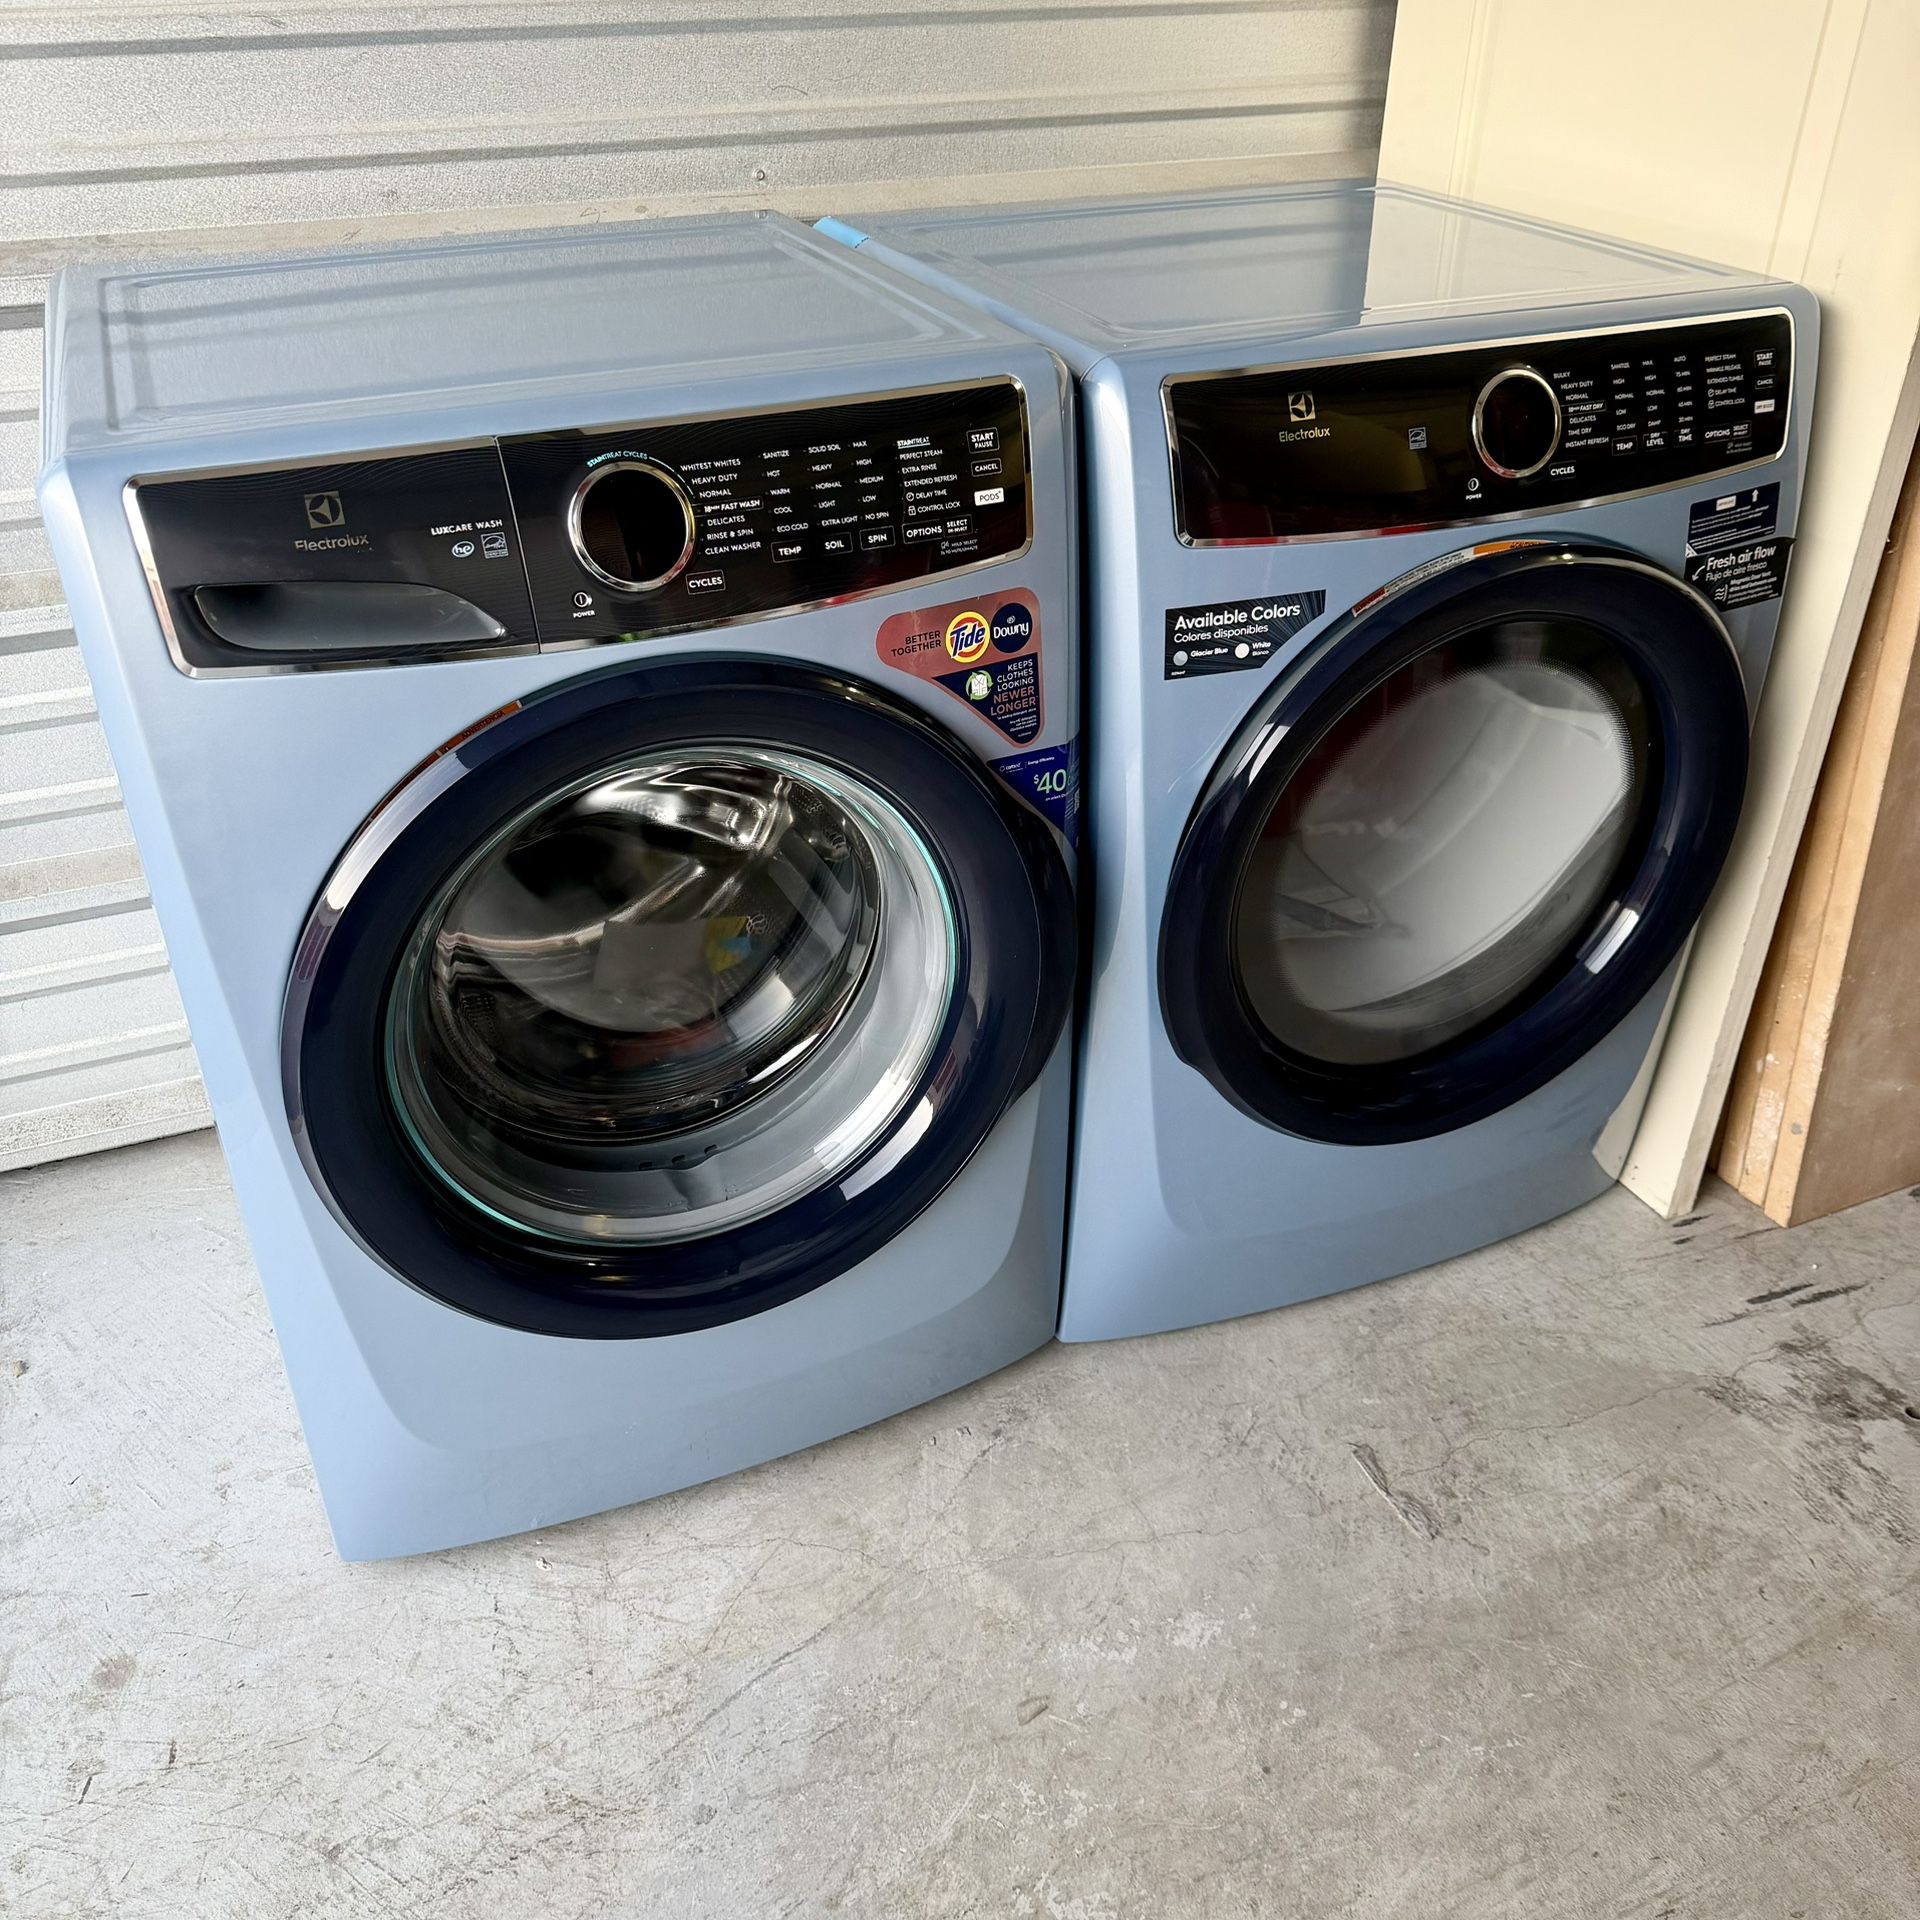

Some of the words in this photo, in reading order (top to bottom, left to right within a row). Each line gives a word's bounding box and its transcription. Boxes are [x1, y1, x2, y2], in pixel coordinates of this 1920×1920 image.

[1566, 393, 1589, 401] NORMAL
[1569, 415, 1596, 424] DELICATES
[971, 432, 994, 442] START
[1278, 426, 1331, 443] Electrolux
[1705, 428, 1730, 439] OPTIONS
[1565, 440, 1586, 448] INSTANT
[1616, 442, 1633, 450] TEMP
[1646, 438, 1664, 446] LEVEL
[762, 450, 790, 459] SANITIZE
[808, 445, 827, 454] SOLID
[899, 451, 923, 460] PERFECT
[924, 449, 943, 457] STEAM
[587, 451, 621, 468] STAINTREAT
[623, 450, 648, 460] CYCLES
[680, 462, 712, 471] WHITEST
[713, 458, 741, 468] WHITES
[812, 463, 833, 472] HEAVY
[902, 466, 920, 474] EXTRA
[921, 463, 937, 471] RINSE
[974, 463, 998, 472] CANCEL
[766, 469, 780, 478] HOT
[1550, 466, 1575, 476] CYCLES
[691, 476, 716, 485] HEAVY
[718, 473, 738, 482] DUTY
[859, 475, 884, 484] MEDIUM
[904, 477, 933, 487] EXTENDED
[934, 474, 958, 483] REFRESH
[815, 481, 842, 490] NORMAL
[699, 488, 732, 498] NORMAL
[915, 491, 933, 499] DELAY
[721, 502, 738, 511] FAST
[739, 499, 761, 508] WASH
[818, 500, 836, 509] LIGHT
[917, 504, 944, 513] CONTROL
[945, 501, 961, 509] LOCK
[774, 506, 792, 514] COOL
[876, 511, 889, 519] SPIN
[707, 514, 746, 526] DELICATES
[821, 518, 840, 526] EXTRA
[841, 516, 858, 524] LIGHT
[946, 519, 968, 528] SELECT
[431, 523, 473, 536] LUXCARE
[475, 519, 503, 529] WASH
[791, 523, 809, 531] COLD
[906, 526, 942, 538] OPTIONS
[706, 531, 728, 540] RINSE
[737, 528, 754, 537] SPIN
[868, 534, 887, 544] SPIN
[705, 546, 730, 555] CLEAN
[731, 541, 761, 551] WASHER
[825, 540, 845, 550] SOIL
[778, 546, 802, 556] TEMP
[1707, 553, 1736, 571] Fresh
[1738, 549, 1753, 563] air
[1754, 546, 1777, 560] flow
[1723, 568, 1732, 578] de
[688, 576, 723, 589] CYCLES
[573, 610, 595, 618] POWER
[1174, 609, 1248, 631] Available
[1251, 604, 1300, 621] Colors
[993, 622, 1029, 638] Downy
[1174, 629, 1212, 643] Colores
[1214, 624, 1269, 640] disponibles
[905, 630, 941, 645] BETTER
[950, 622, 986, 659] Tide
[891, 640, 942, 657] TOGETHER
[1190, 648, 1214, 657] Glacier
[1007, 659, 1033, 672] KEEPS
[997, 668, 1034, 683] CLOTHES
[997, 677, 1034, 692] LOOKING
[993, 686, 1035, 704] NEWER
